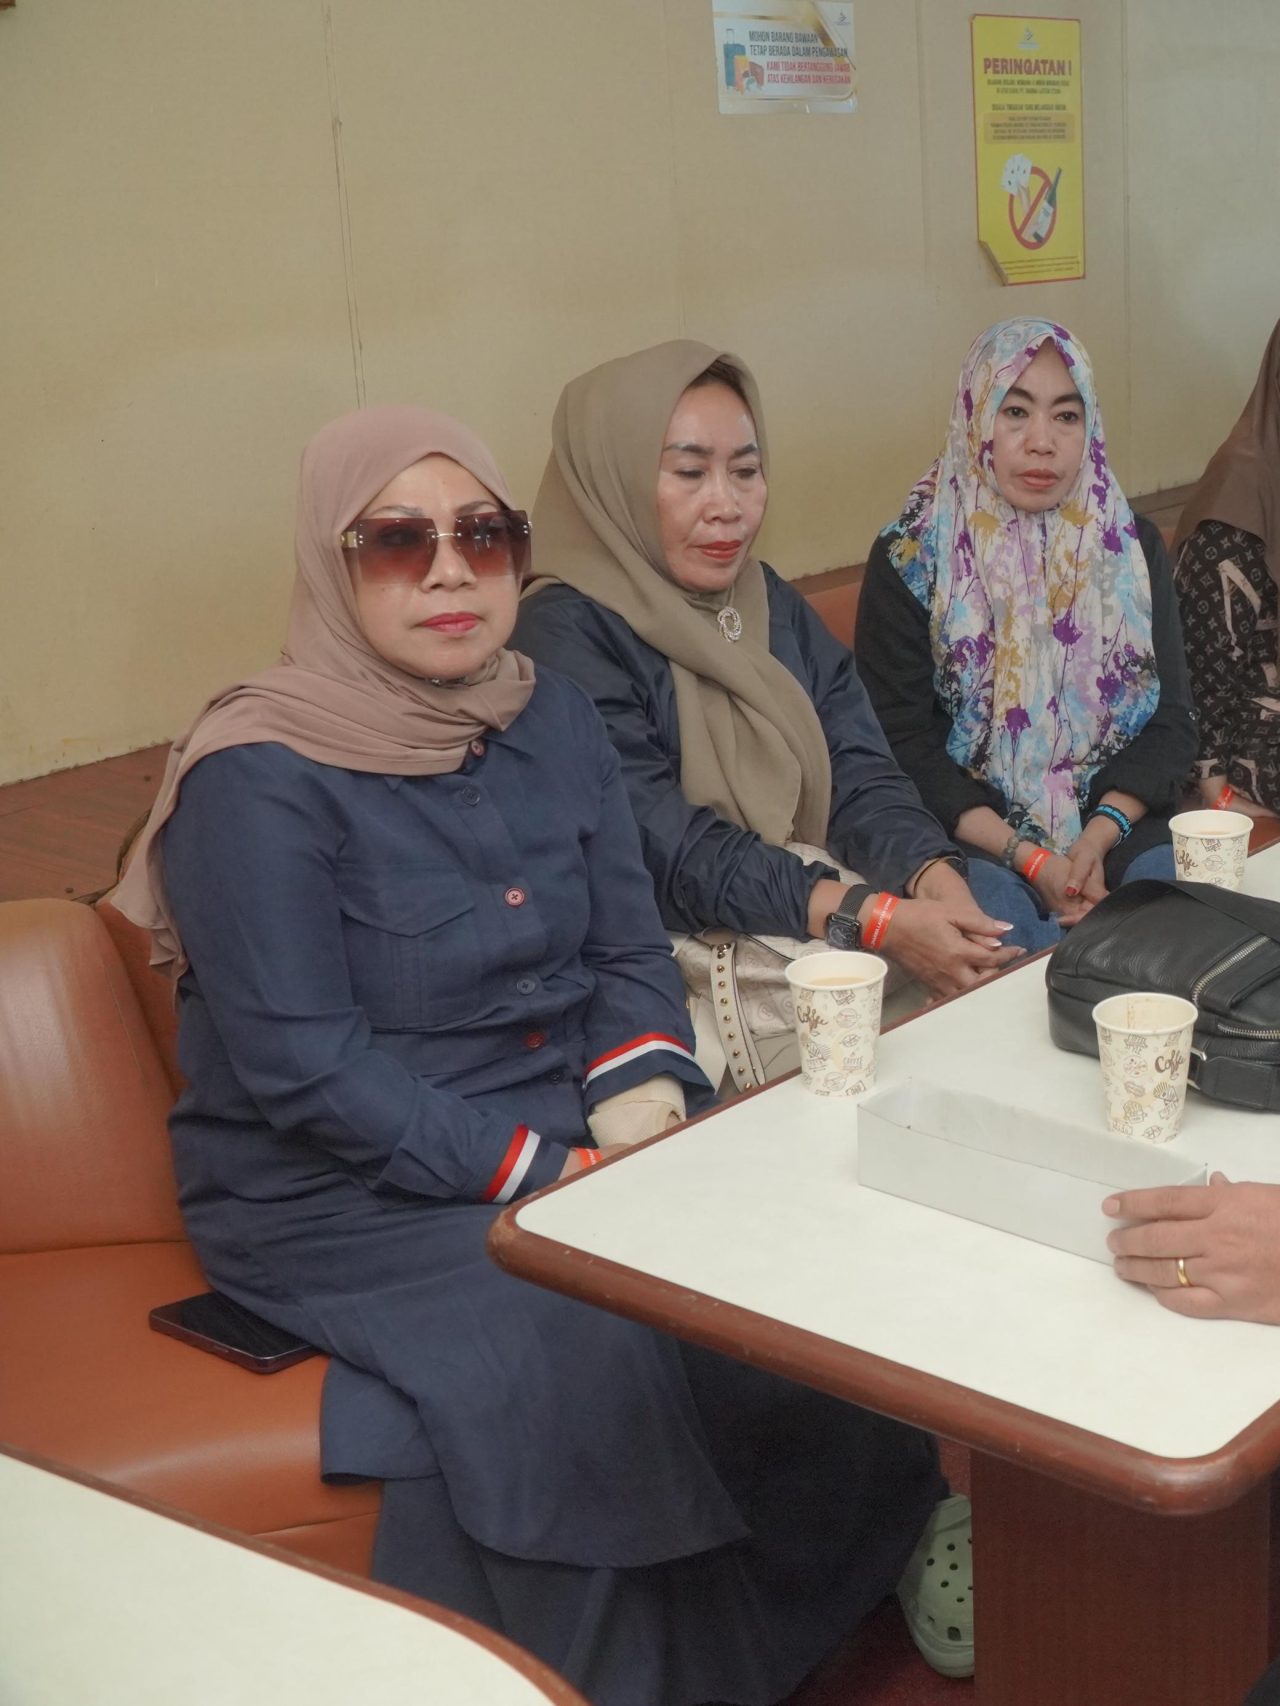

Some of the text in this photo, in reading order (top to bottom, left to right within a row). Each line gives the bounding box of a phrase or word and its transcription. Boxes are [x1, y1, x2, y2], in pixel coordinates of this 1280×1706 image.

[749, 30, 818, 44] MOHON BARANG BAWAAN
[750, 44, 848, 57] TETAP BERADA DALAM PENGAWASAN
[984, 58, 1065, 76] PERINGATAN
